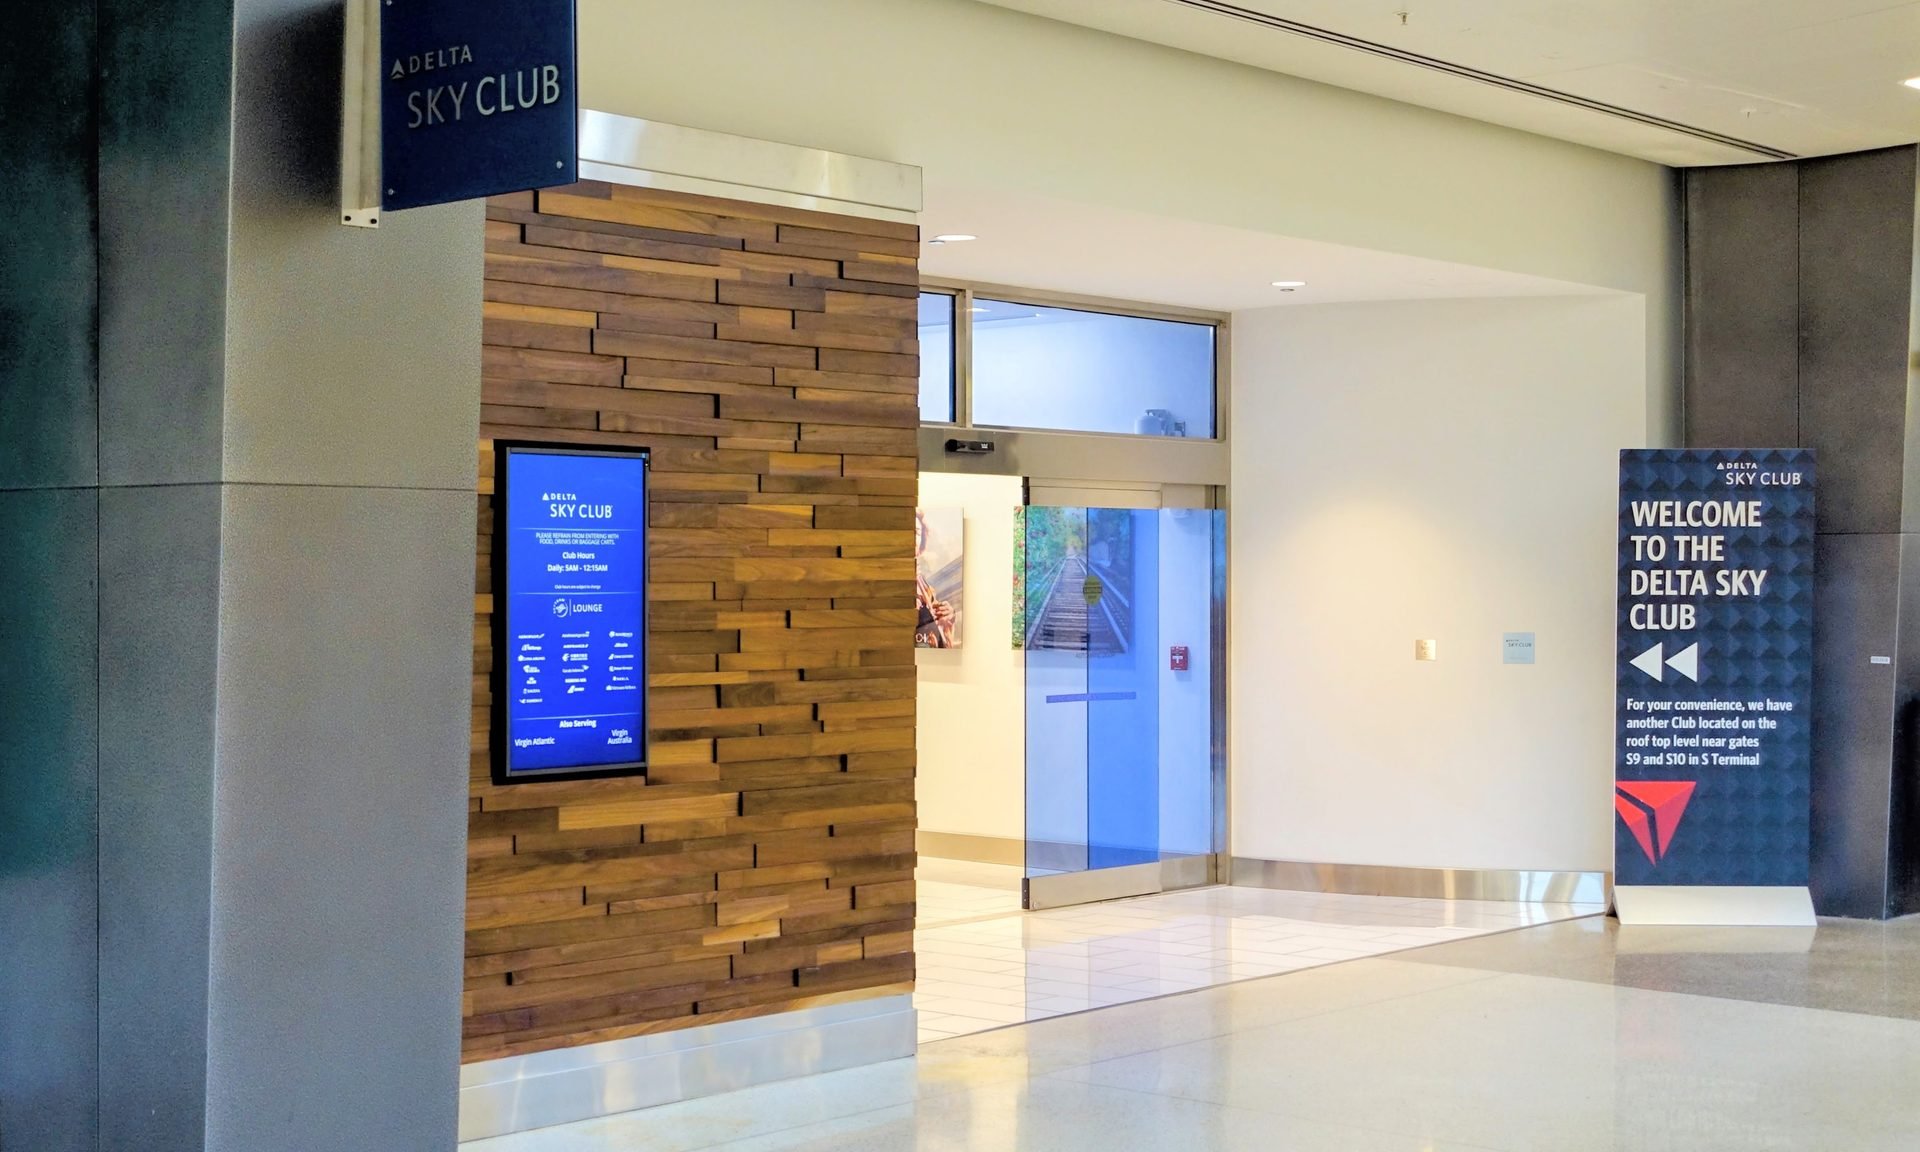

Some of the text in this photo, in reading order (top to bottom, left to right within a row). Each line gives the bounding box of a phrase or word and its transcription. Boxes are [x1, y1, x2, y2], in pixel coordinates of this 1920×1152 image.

[410, 44, 472, 74] DELTA
[408, 64, 560, 128] SKY CLUB
[1726, 472, 1801, 485] SKY CLUB
[550, 504, 612, 518] SKY CLUB
[1631, 501, 1762, 527] WELCOME
[1631, 535, 1724, 561] TO THE
[548, 564, 564, 573] Daily:
[1631, 570, 1767, 596] DELTA SKY
[573, 604, 603, 612] LOUNGE
[1630, 604, 1696, 630] CLUB
[1626, 698, 1792, 712] For your convenience, we have
[559, 719, 597, 728] Also Serving
[1626, 716, 1777, 729] another Club located on the
[611, 729, 628, 737] Virgin
[515, 737, 555, 748] Virgin Atlantic
[1626, 735, 1759, 750] roof top level near gates
[1626, 753, 1760, 765] S9 and S10 in S Terminal
